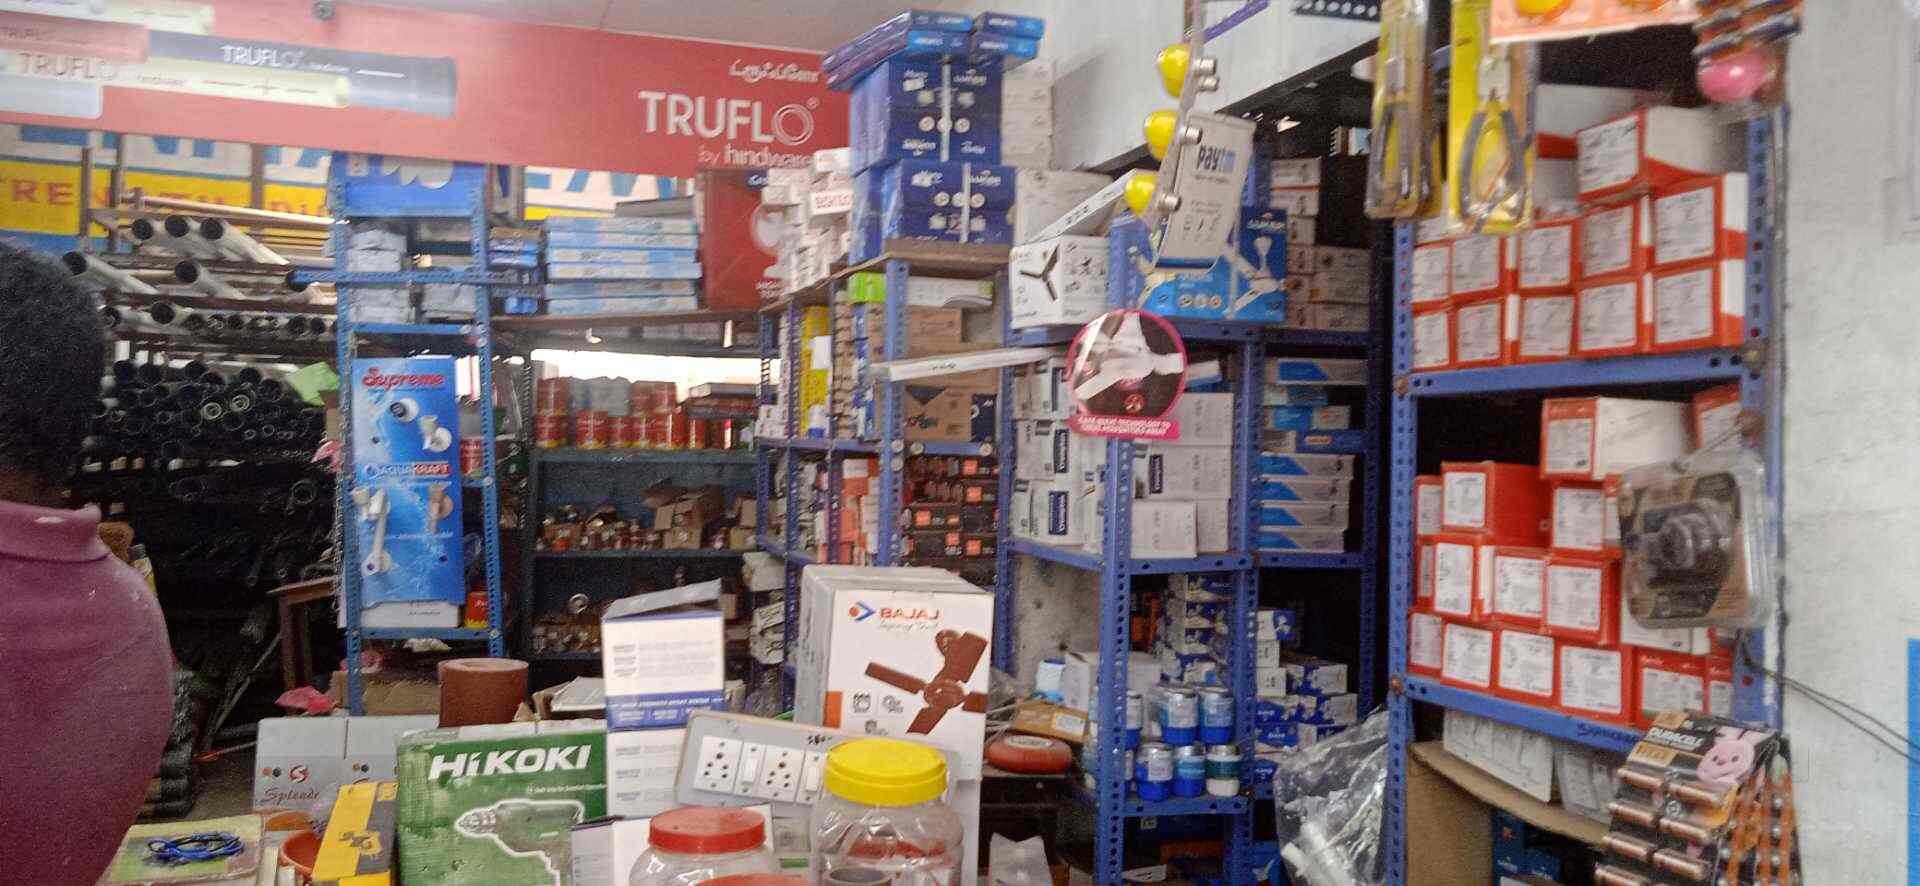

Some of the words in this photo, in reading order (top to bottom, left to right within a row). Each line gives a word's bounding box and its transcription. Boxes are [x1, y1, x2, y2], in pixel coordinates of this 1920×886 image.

[638, 90, 815, 146] TRUFLO
[362, 368, 444, 390] Supreme
[880, 607, 941, 620] BAJAJ
